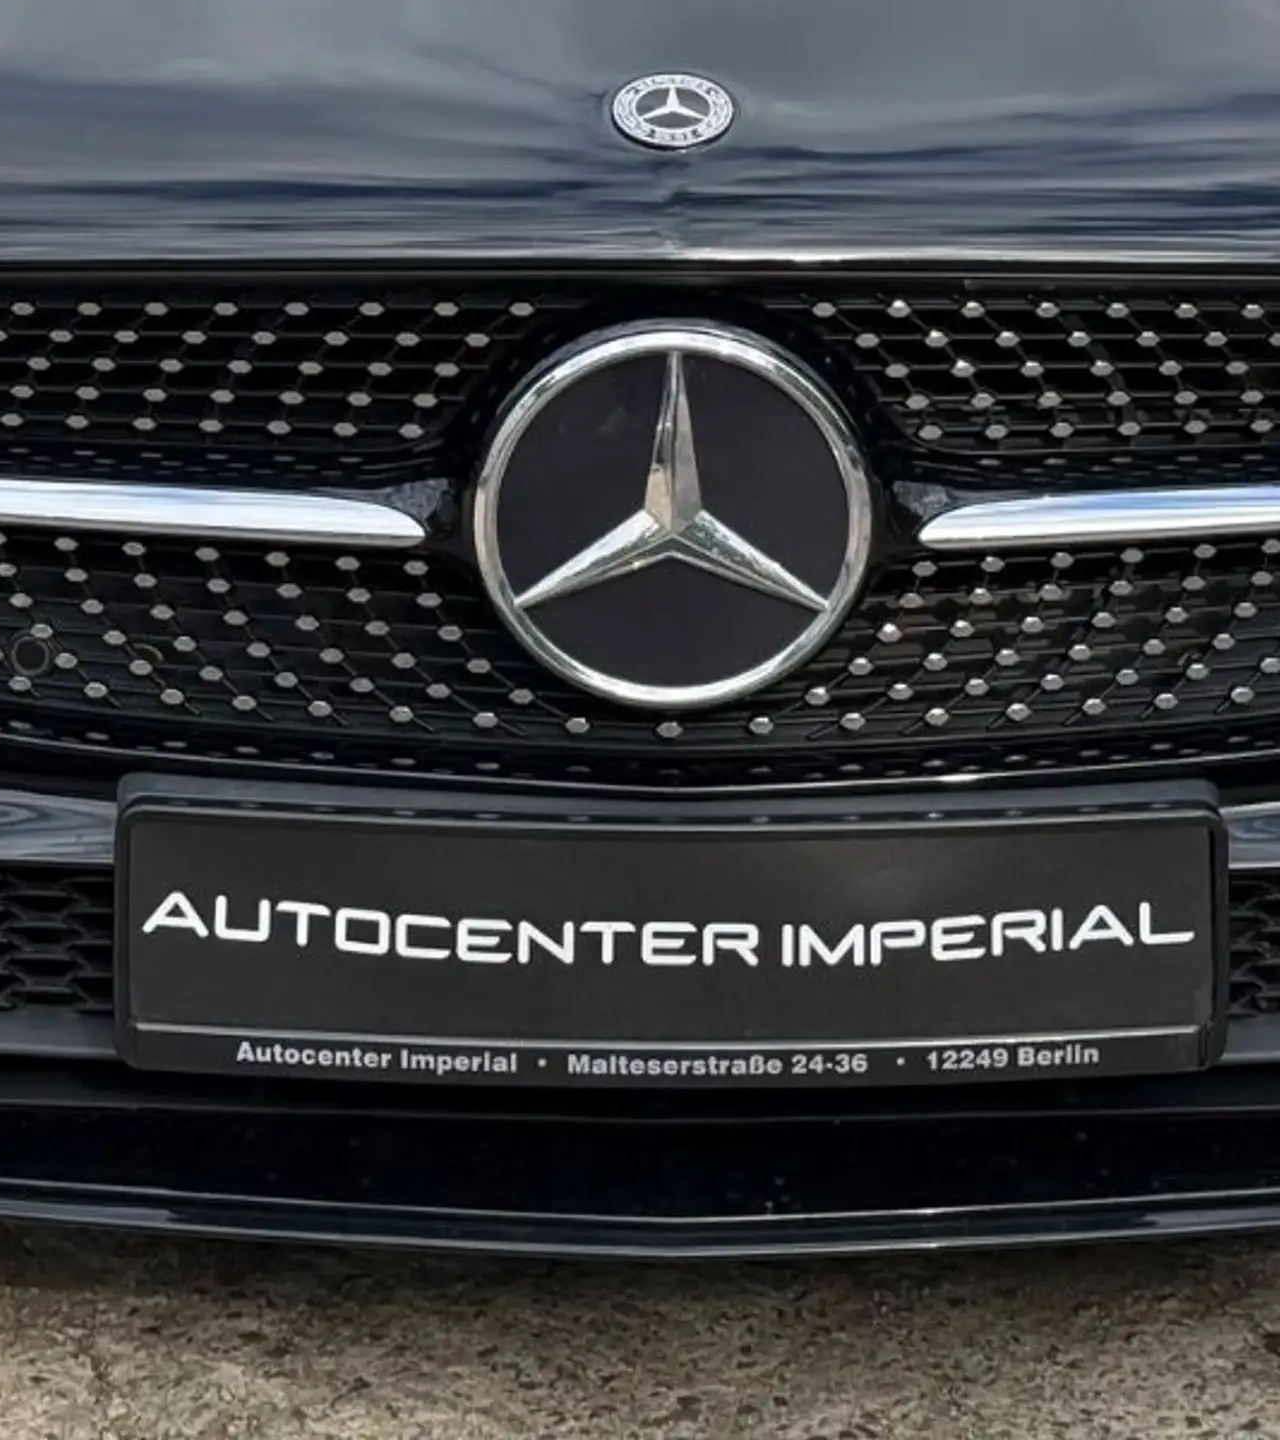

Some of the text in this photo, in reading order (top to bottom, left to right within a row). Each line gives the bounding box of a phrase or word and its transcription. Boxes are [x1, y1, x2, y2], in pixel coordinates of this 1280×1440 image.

[141, 891, 1195, 967] AUTOCENTER IMPERIAL
[236, 1041, 1099, 1077] Autocenter Imperial Malteserstraße 24-36 12249 Berlin
